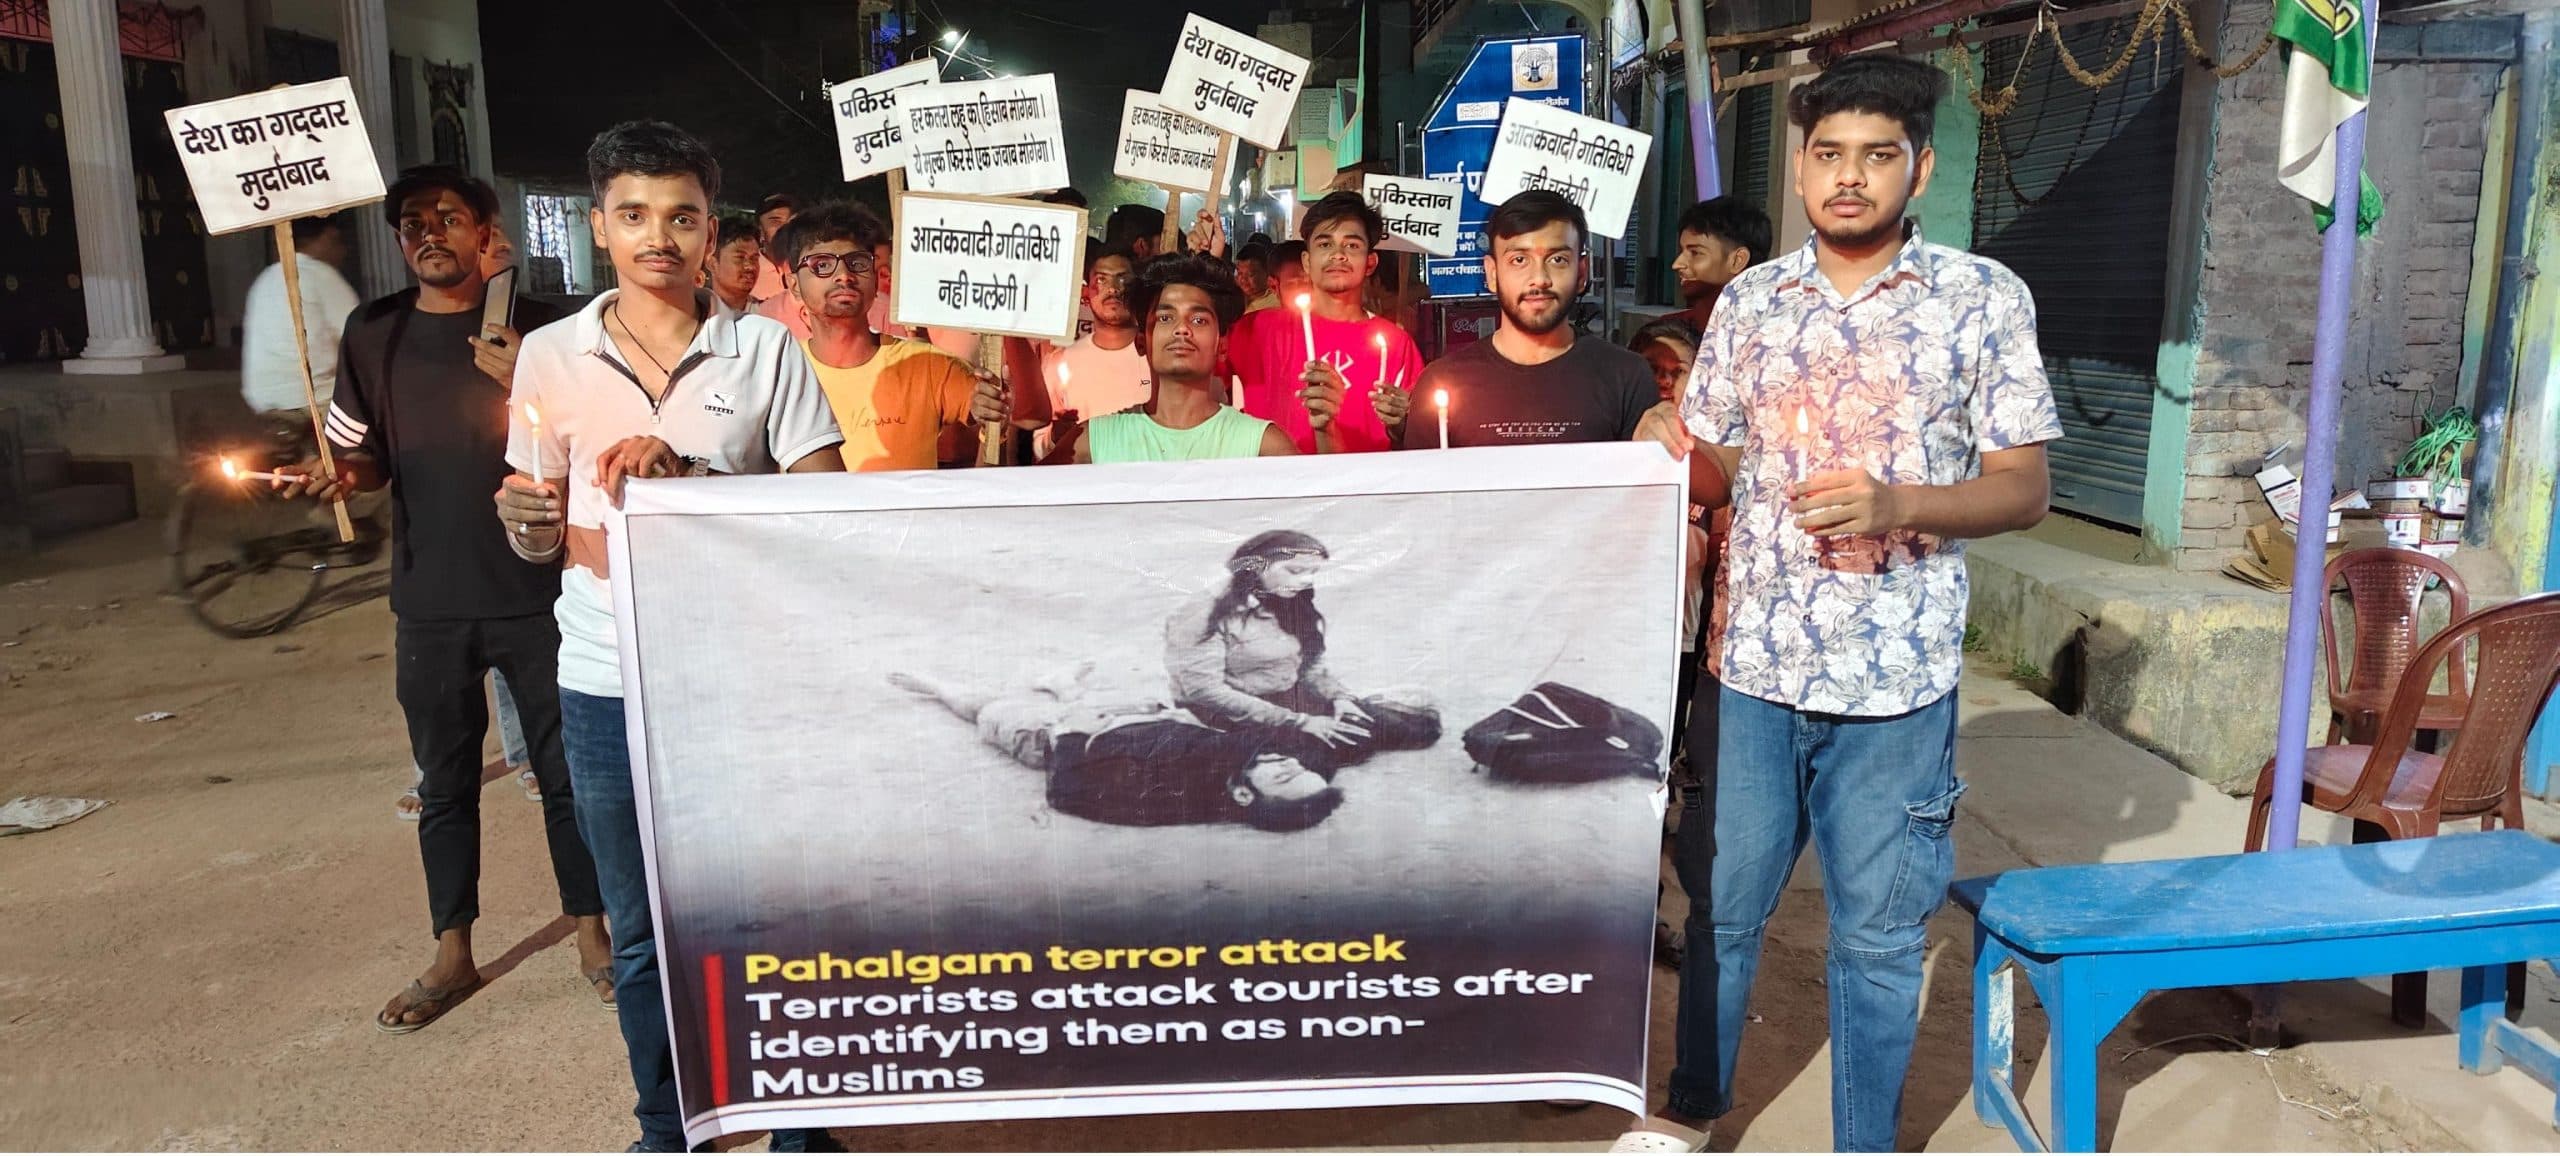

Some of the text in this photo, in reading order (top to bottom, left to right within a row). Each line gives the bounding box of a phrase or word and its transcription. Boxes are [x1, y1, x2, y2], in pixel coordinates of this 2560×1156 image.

[1183, 26, 1297, 92] देश का गद्दार
[910, 107, 924, 133] हर
[924, 105, 949, 129] कतरा
[980, 91, 1008, 127] हिसाब
[1008, 89, 1039, 121] मांगेगा
[1131, 106, 1143, 126] हर
[1142, 108, 1161, 128] कतरा
[1195, 77, 1259, 119] मुर्दाबाद
[180, 100, 350, 155] देश का गद्दार
[1125, 132, 1132, 155] ये
[1149, 136, 1161, 162] फिर
[1169, 147, 1182, 165] एक
[1506, 120, 1634, 176] आतंकवादी गतिविधी
[236, 153, 330, 210] मुर्दाबाद
[913, 144, 923, 176] ये
[922, 151, 945, 188] मुल्क
[946, 139, 965, 172] फिर
[965, 140, 974, 171] से
[975, 147, 991, 171] एक
[1018, 133, 1049, 165] मांगेगा
[911, 218, 1060, 263] आतंकवादी गतिविधी
[938, 269, 969, 310] नही
[972, 273, 1018, 311] चलेगी
[745, 934, 1408, 985] Pahalgam terror attack
[745, 967, 1594, 1021] Terrorists attack tourists after
[749, 1013, 1426, 1060] identifying them as non-
[752, 1062, 985, 1098] Muslims
